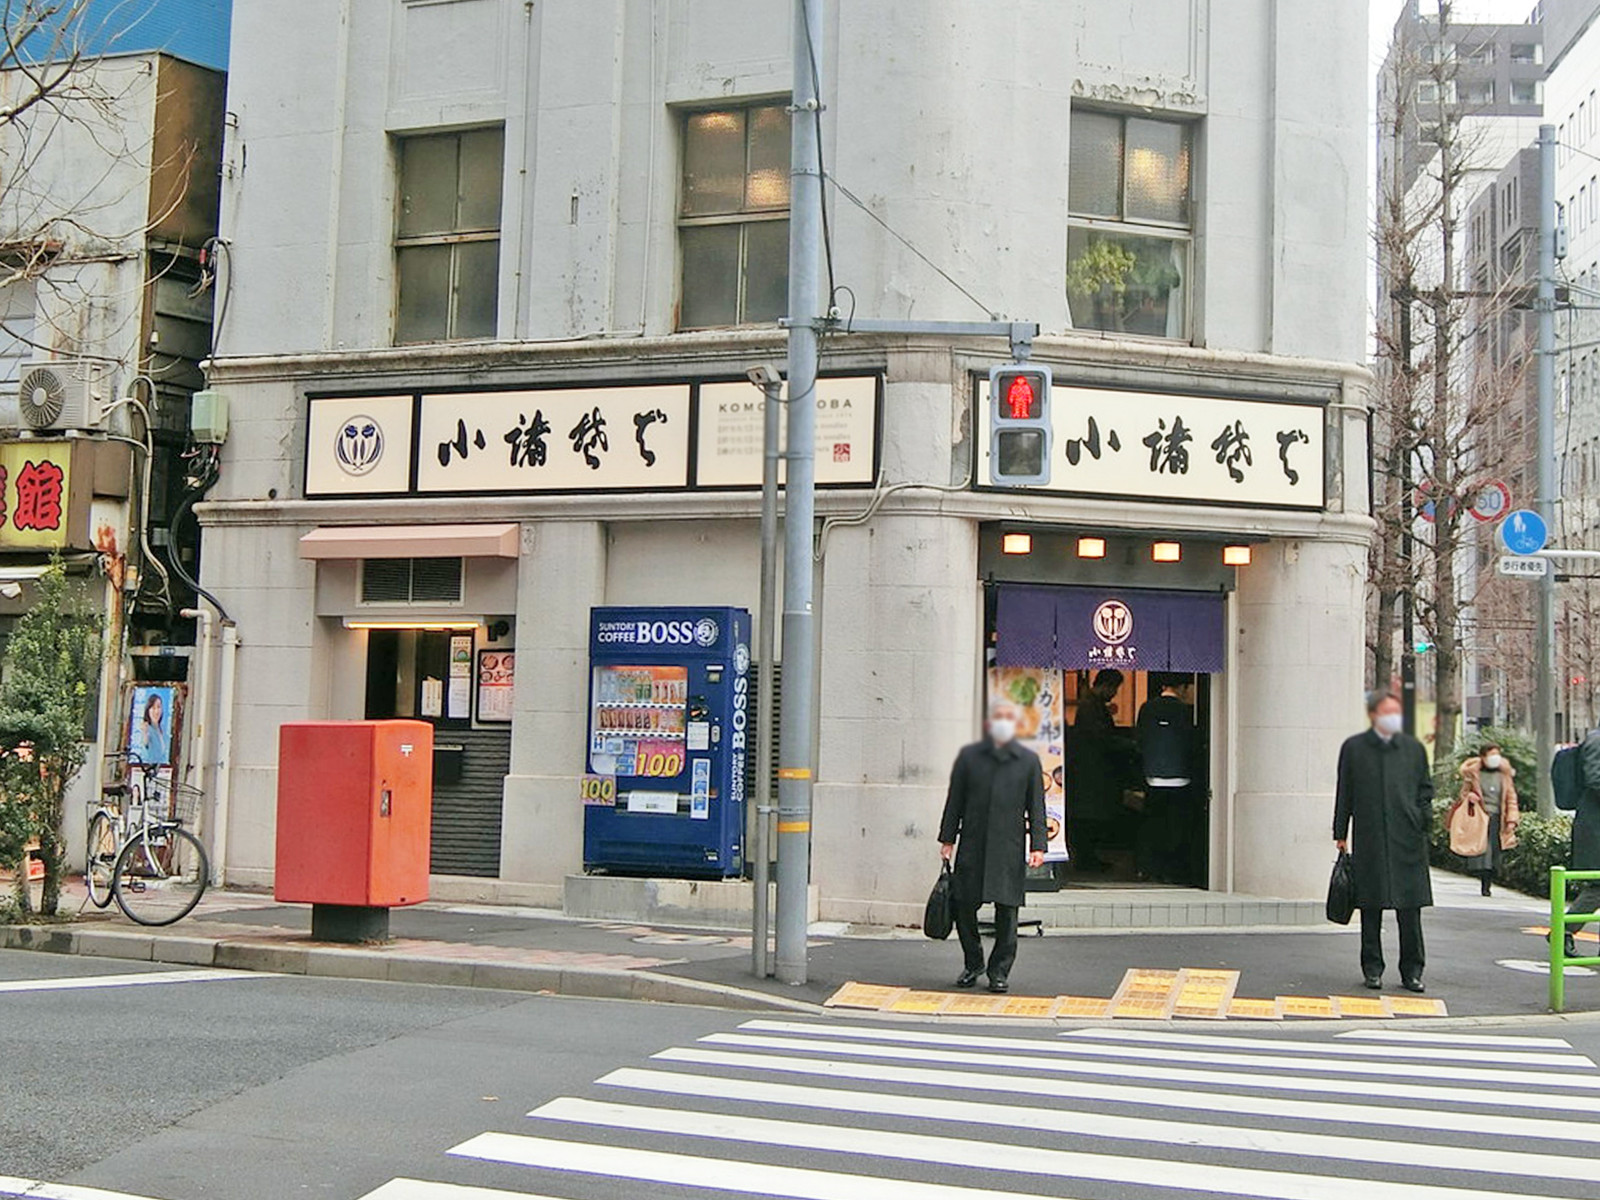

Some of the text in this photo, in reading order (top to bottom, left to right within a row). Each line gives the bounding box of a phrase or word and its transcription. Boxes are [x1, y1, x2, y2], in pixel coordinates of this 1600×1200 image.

[1503, 561, 1543, 573] 歩行者優先
[598, 632, 636, 642] COFFEE
[599, 622, 636, 631] SUNTORY
[636, 621, 693, 643] BOSS
[732, 677, 748, 749] BOSS
[637, 753, 681, 777] 100
[582, 779, 614, 800] 100
